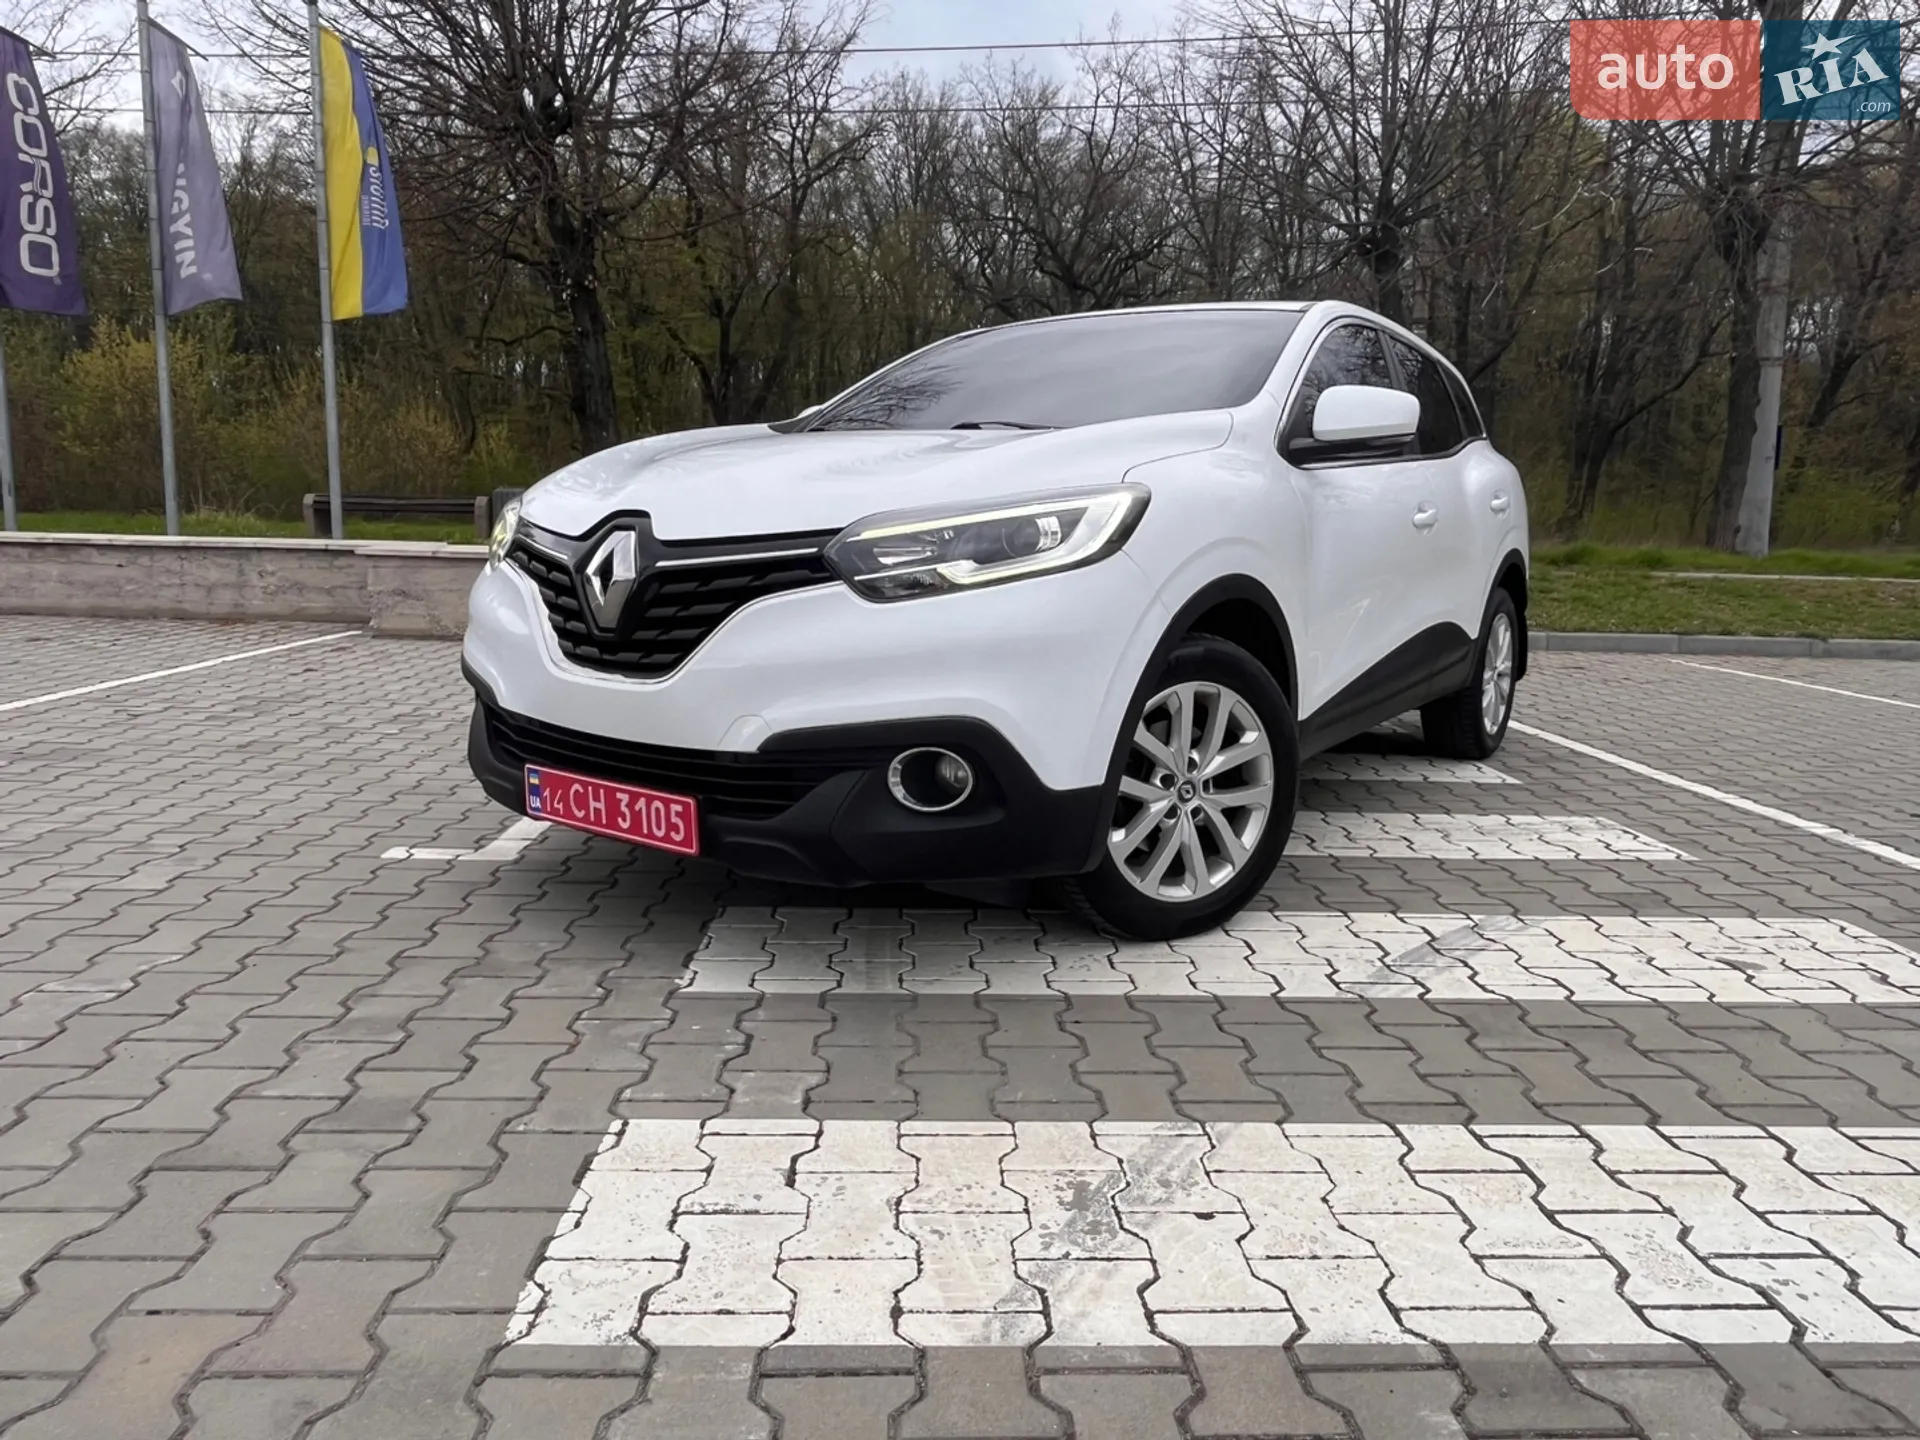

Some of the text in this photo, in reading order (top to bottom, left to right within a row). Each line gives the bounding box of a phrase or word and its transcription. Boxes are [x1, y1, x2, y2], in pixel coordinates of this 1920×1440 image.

[7, 73, 60, 277] CORSO
[529, 795, 542, 809] UA
[543, 783, 686, 842] 14 CH 3105
